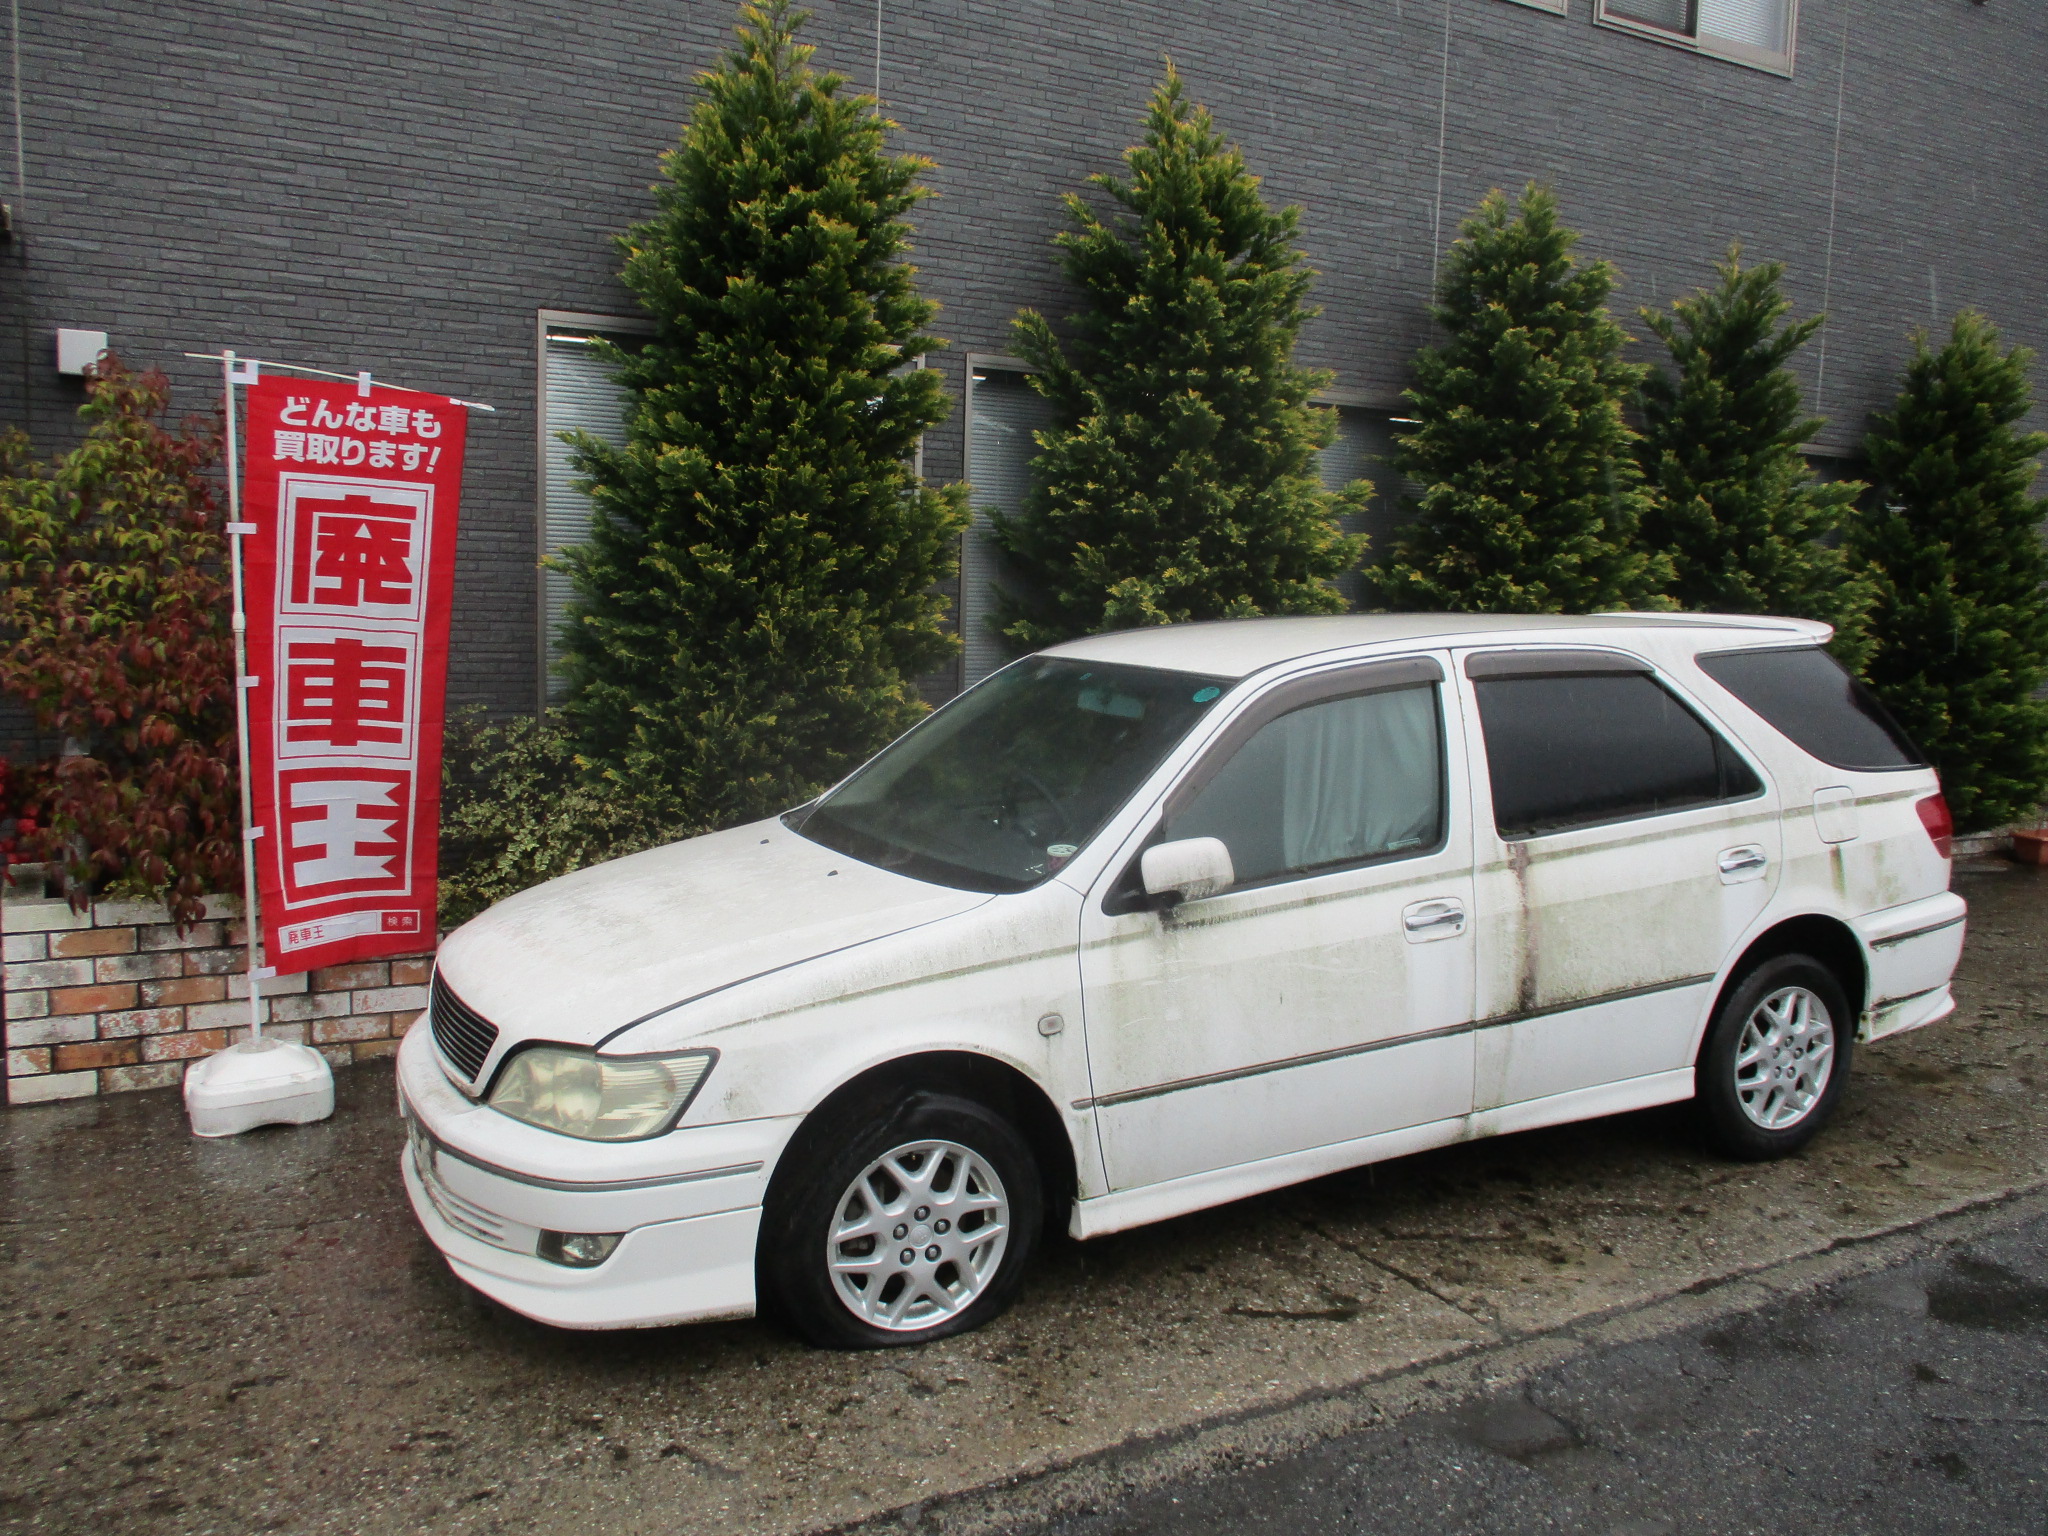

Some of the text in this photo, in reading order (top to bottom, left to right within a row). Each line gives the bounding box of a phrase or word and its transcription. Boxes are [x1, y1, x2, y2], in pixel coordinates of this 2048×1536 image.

[279, 396, 441, 438] どんな車も
[273, 429, 441, 473] 買取ります!
[286, 494, 417, 887] 廃車王
[288, 925, 324, 945] 廃車王
[386, 916, 413, 928] 検索
